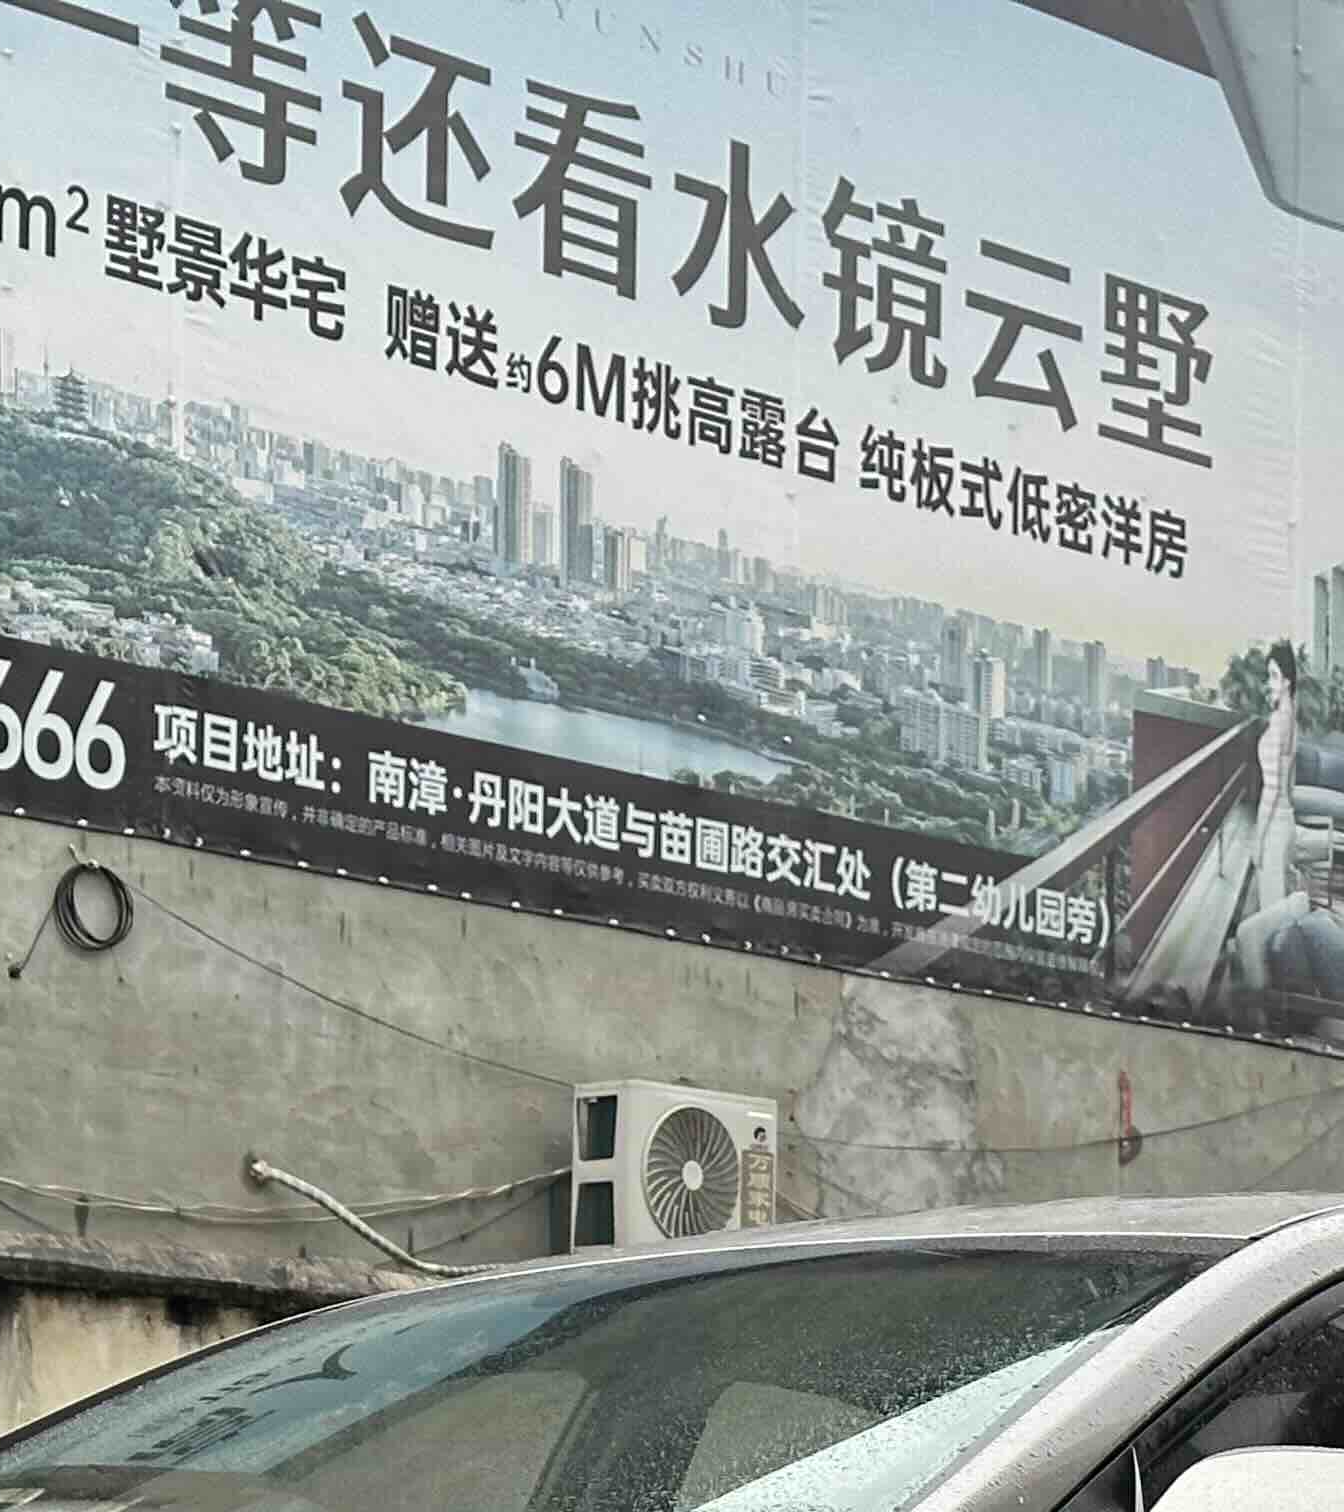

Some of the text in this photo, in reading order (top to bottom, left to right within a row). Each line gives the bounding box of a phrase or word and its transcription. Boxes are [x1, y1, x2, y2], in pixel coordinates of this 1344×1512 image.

[104, 194, 346, 342] 墅景华宅
[859, 424, 1189, 579] 纯板式低密洋房
